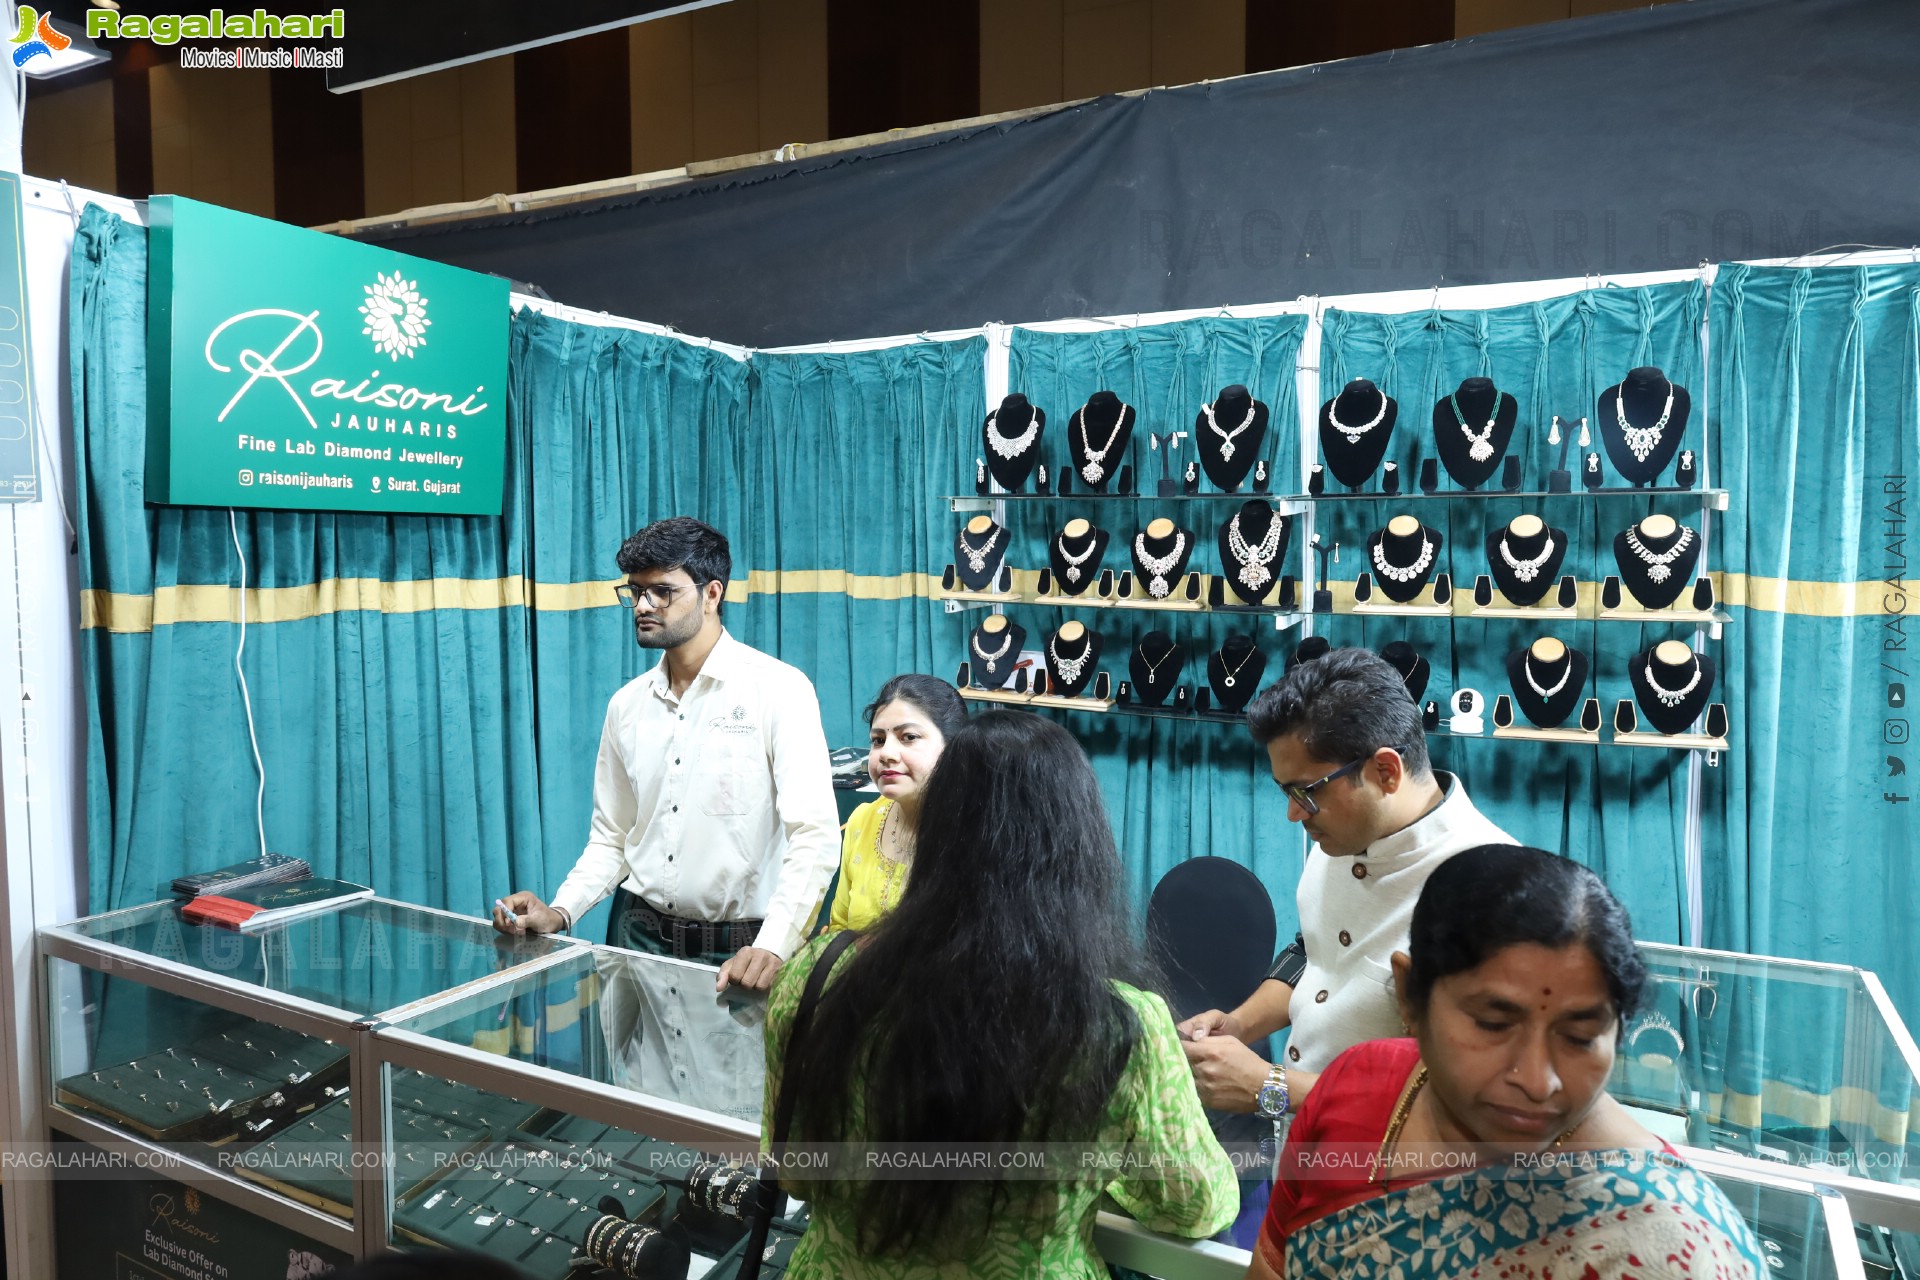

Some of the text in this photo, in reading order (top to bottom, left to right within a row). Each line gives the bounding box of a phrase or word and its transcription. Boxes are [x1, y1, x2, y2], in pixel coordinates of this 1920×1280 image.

[205, 308, 488, 429] Raisoni
[331, 413, 457, 439] JAUHARIS
[238, 434, 464, 469] Fine Lab Diamond Jewellery
[258, 471, 353, 489] raisonijauharis
[423, 479, 461, 496] Gujarat
[143, 1244, 160, 1262] Lab
[161, 1253, 204, 1280] Diamond
[145, 1229, 228, 1279] Exclusive Offer on
